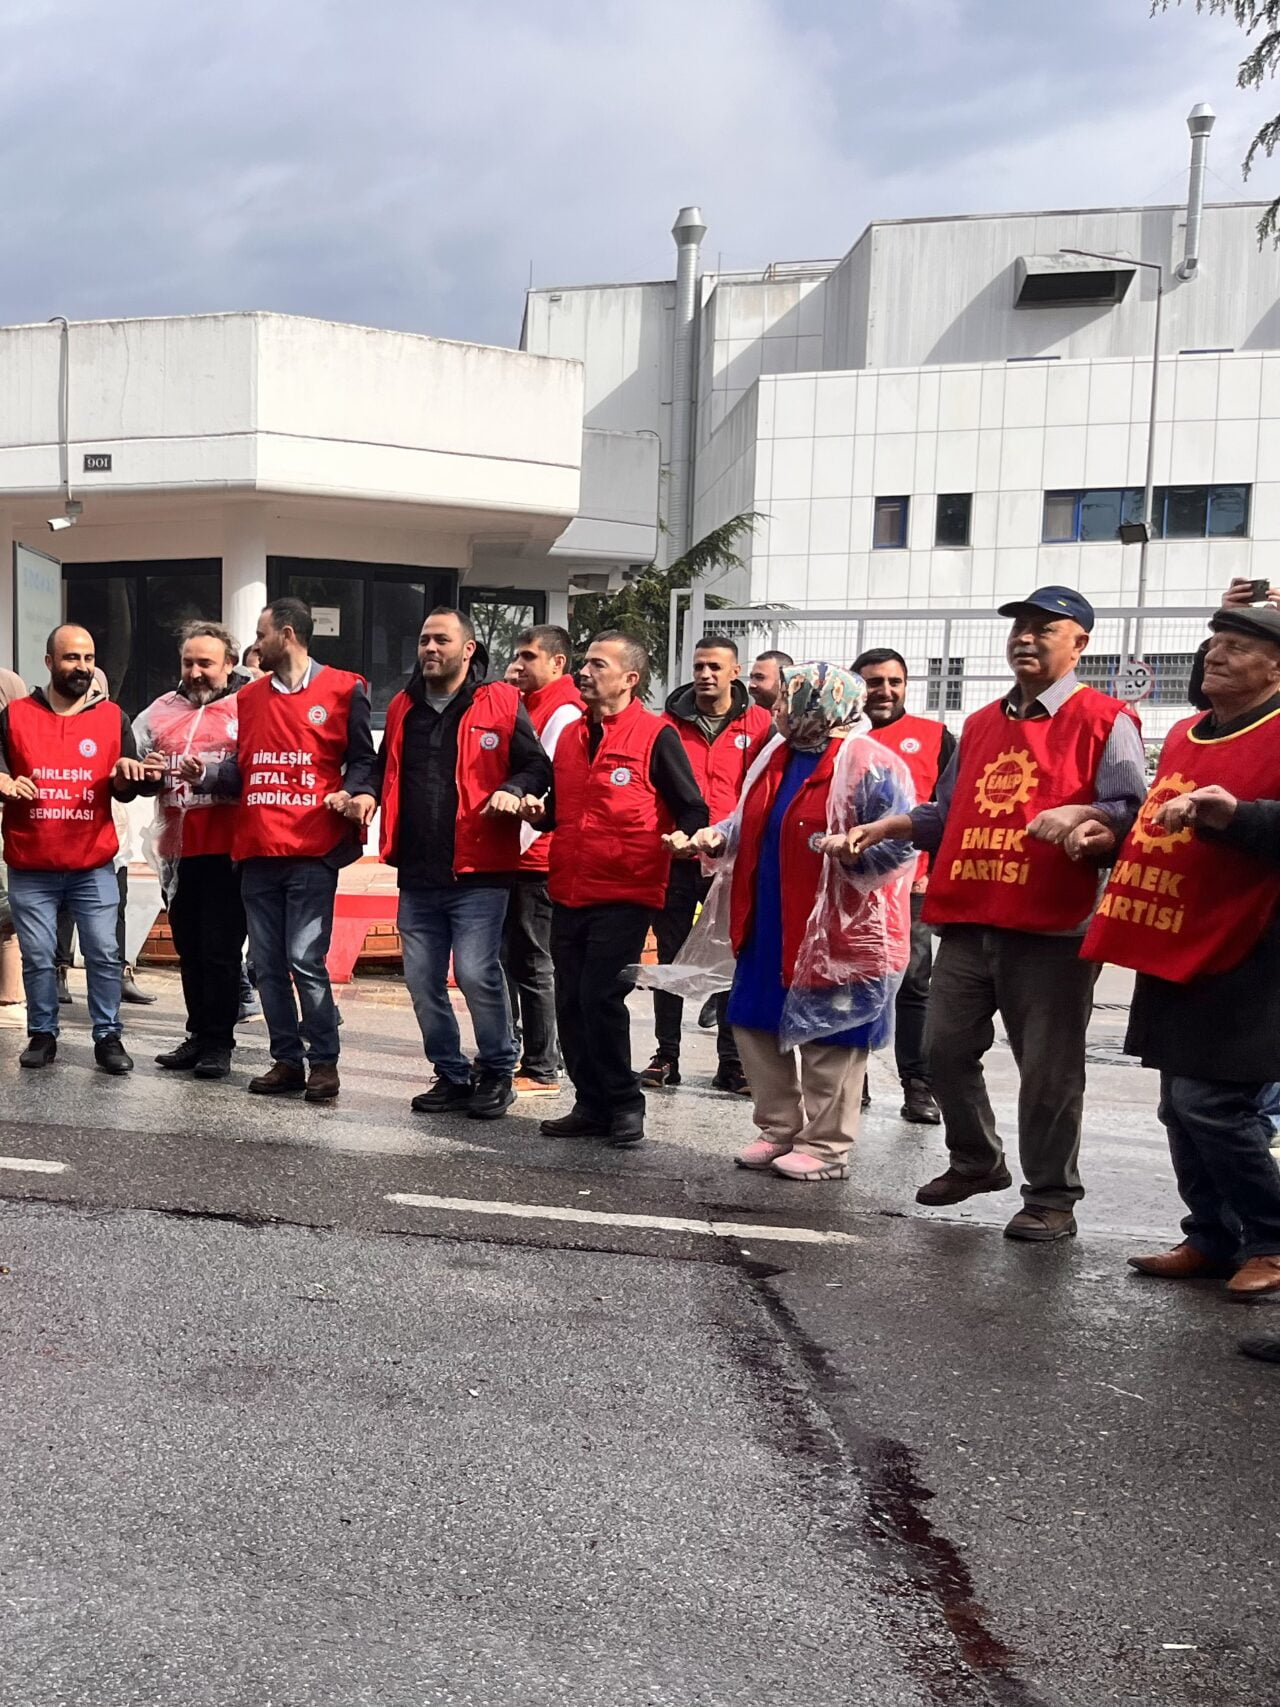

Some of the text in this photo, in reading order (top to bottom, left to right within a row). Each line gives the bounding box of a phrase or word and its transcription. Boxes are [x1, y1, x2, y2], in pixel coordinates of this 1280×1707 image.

[87, 457, 108, 468] 901
[252, 749, 313, 768] BİRLEŞİK
[301, 770, 316, 789] İŞ
[986, 773, 1023, 790] EMEP
[82, 786, 95, 803] İŞ
[29, 805, 94, 820] SENDİKASI
[961, 827, 1028, 852] EMEK
[949, 853, 1030, 885] PARTİSİ
[1096, 892, 1185, 934] ARTİSİ
